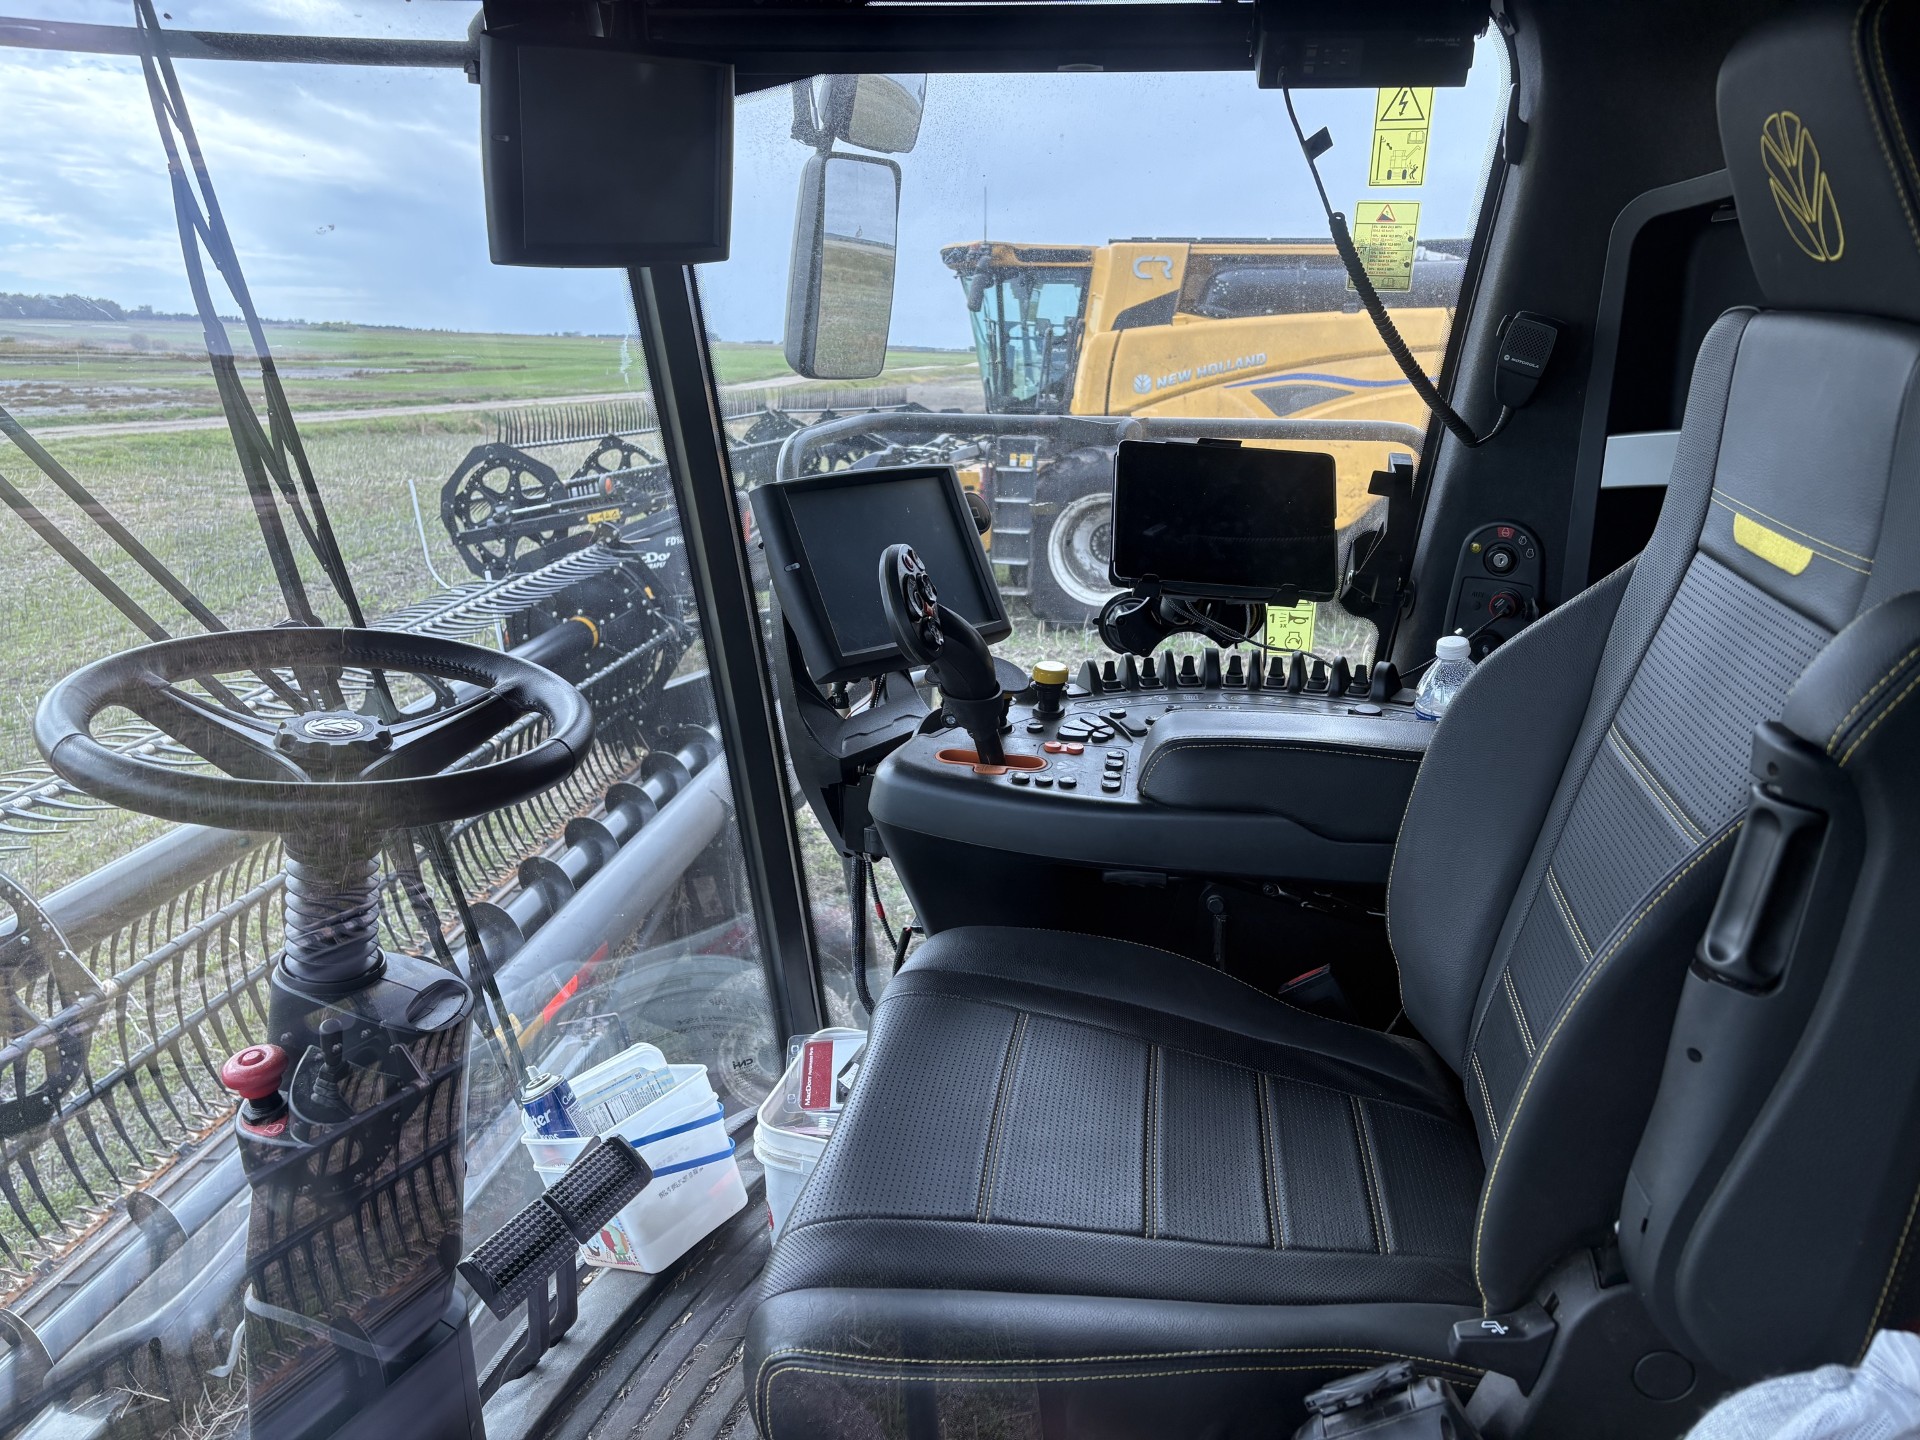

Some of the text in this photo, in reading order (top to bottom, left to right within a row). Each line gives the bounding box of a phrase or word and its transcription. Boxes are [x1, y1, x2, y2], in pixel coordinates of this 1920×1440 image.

[1132, 255, 1174, 280] CR
[1156, 352, 1267, 390] NEW HOLLAND
[1511, 357, 1539, 369] MOTOROLA
[1269, 613, 1275, 624] 1
[1268, 636, 1275, 646] 2
[804, 1076, 812, 1106] MacDon
